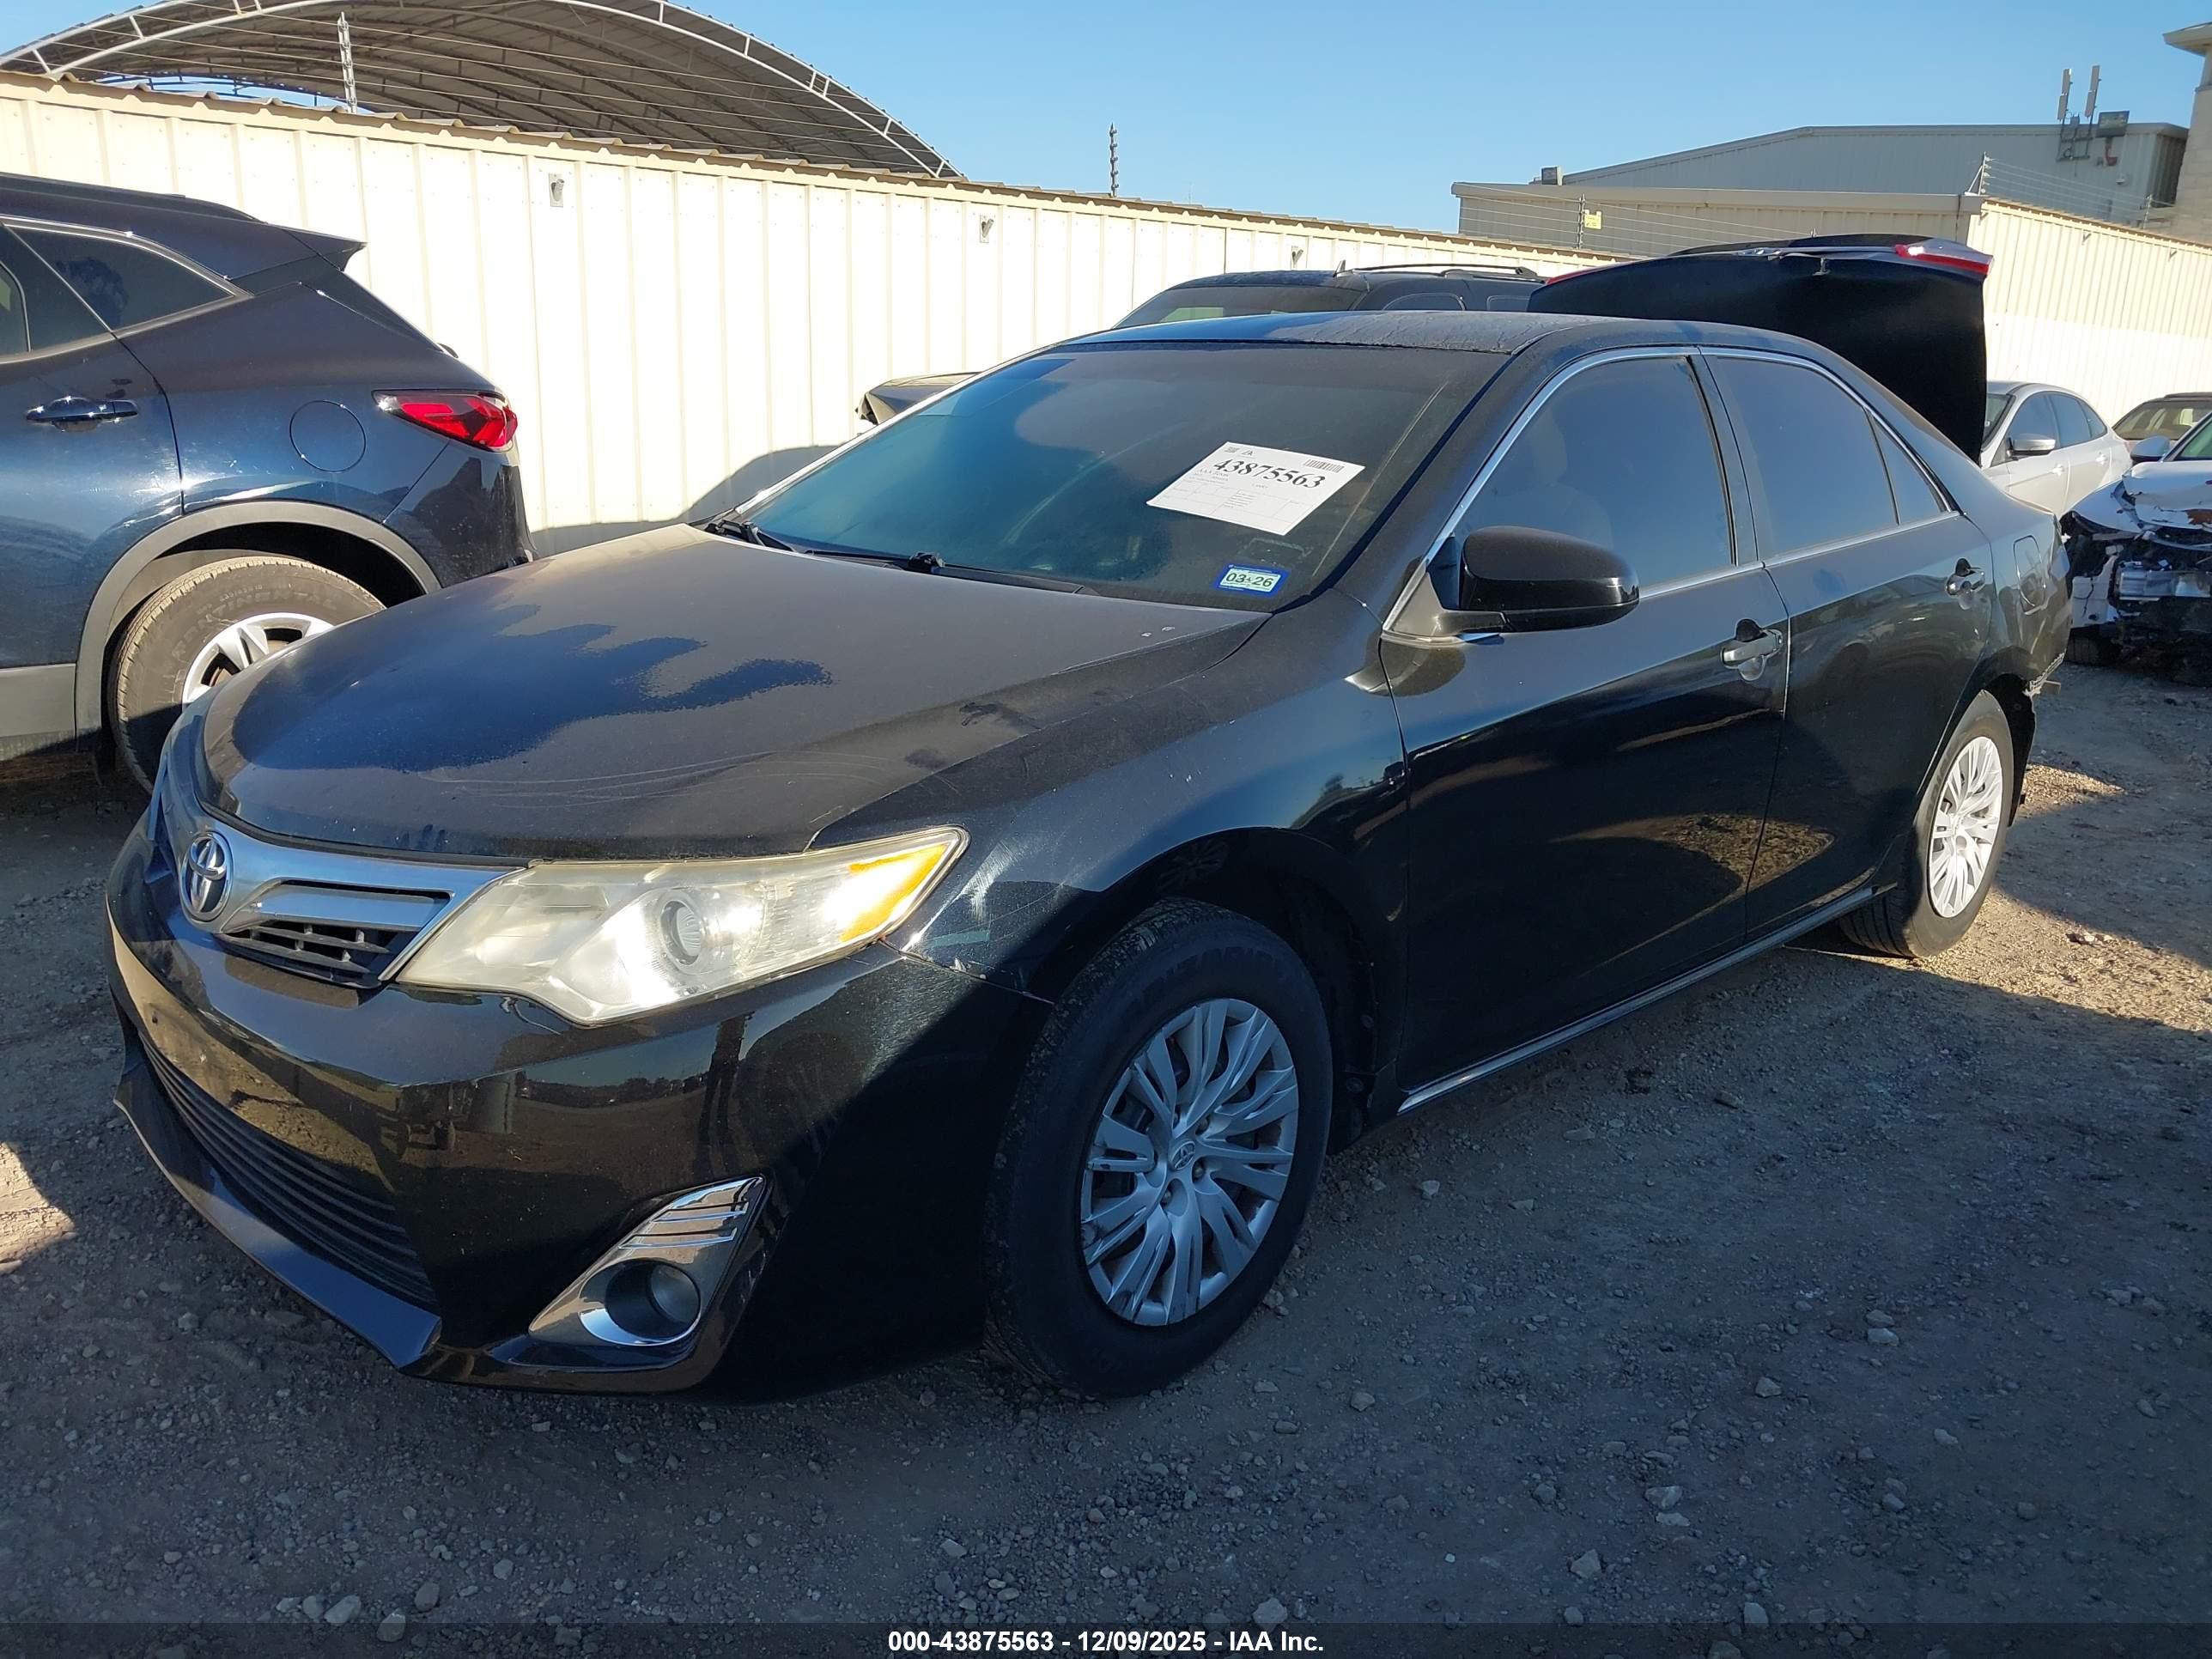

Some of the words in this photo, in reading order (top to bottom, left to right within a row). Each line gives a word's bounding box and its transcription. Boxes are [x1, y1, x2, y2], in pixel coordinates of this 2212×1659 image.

[1213, 459, 1326, 489] 43875563
[1225, 572, 1247, 583] 03
[1251, 576, 1274, 587] 26
